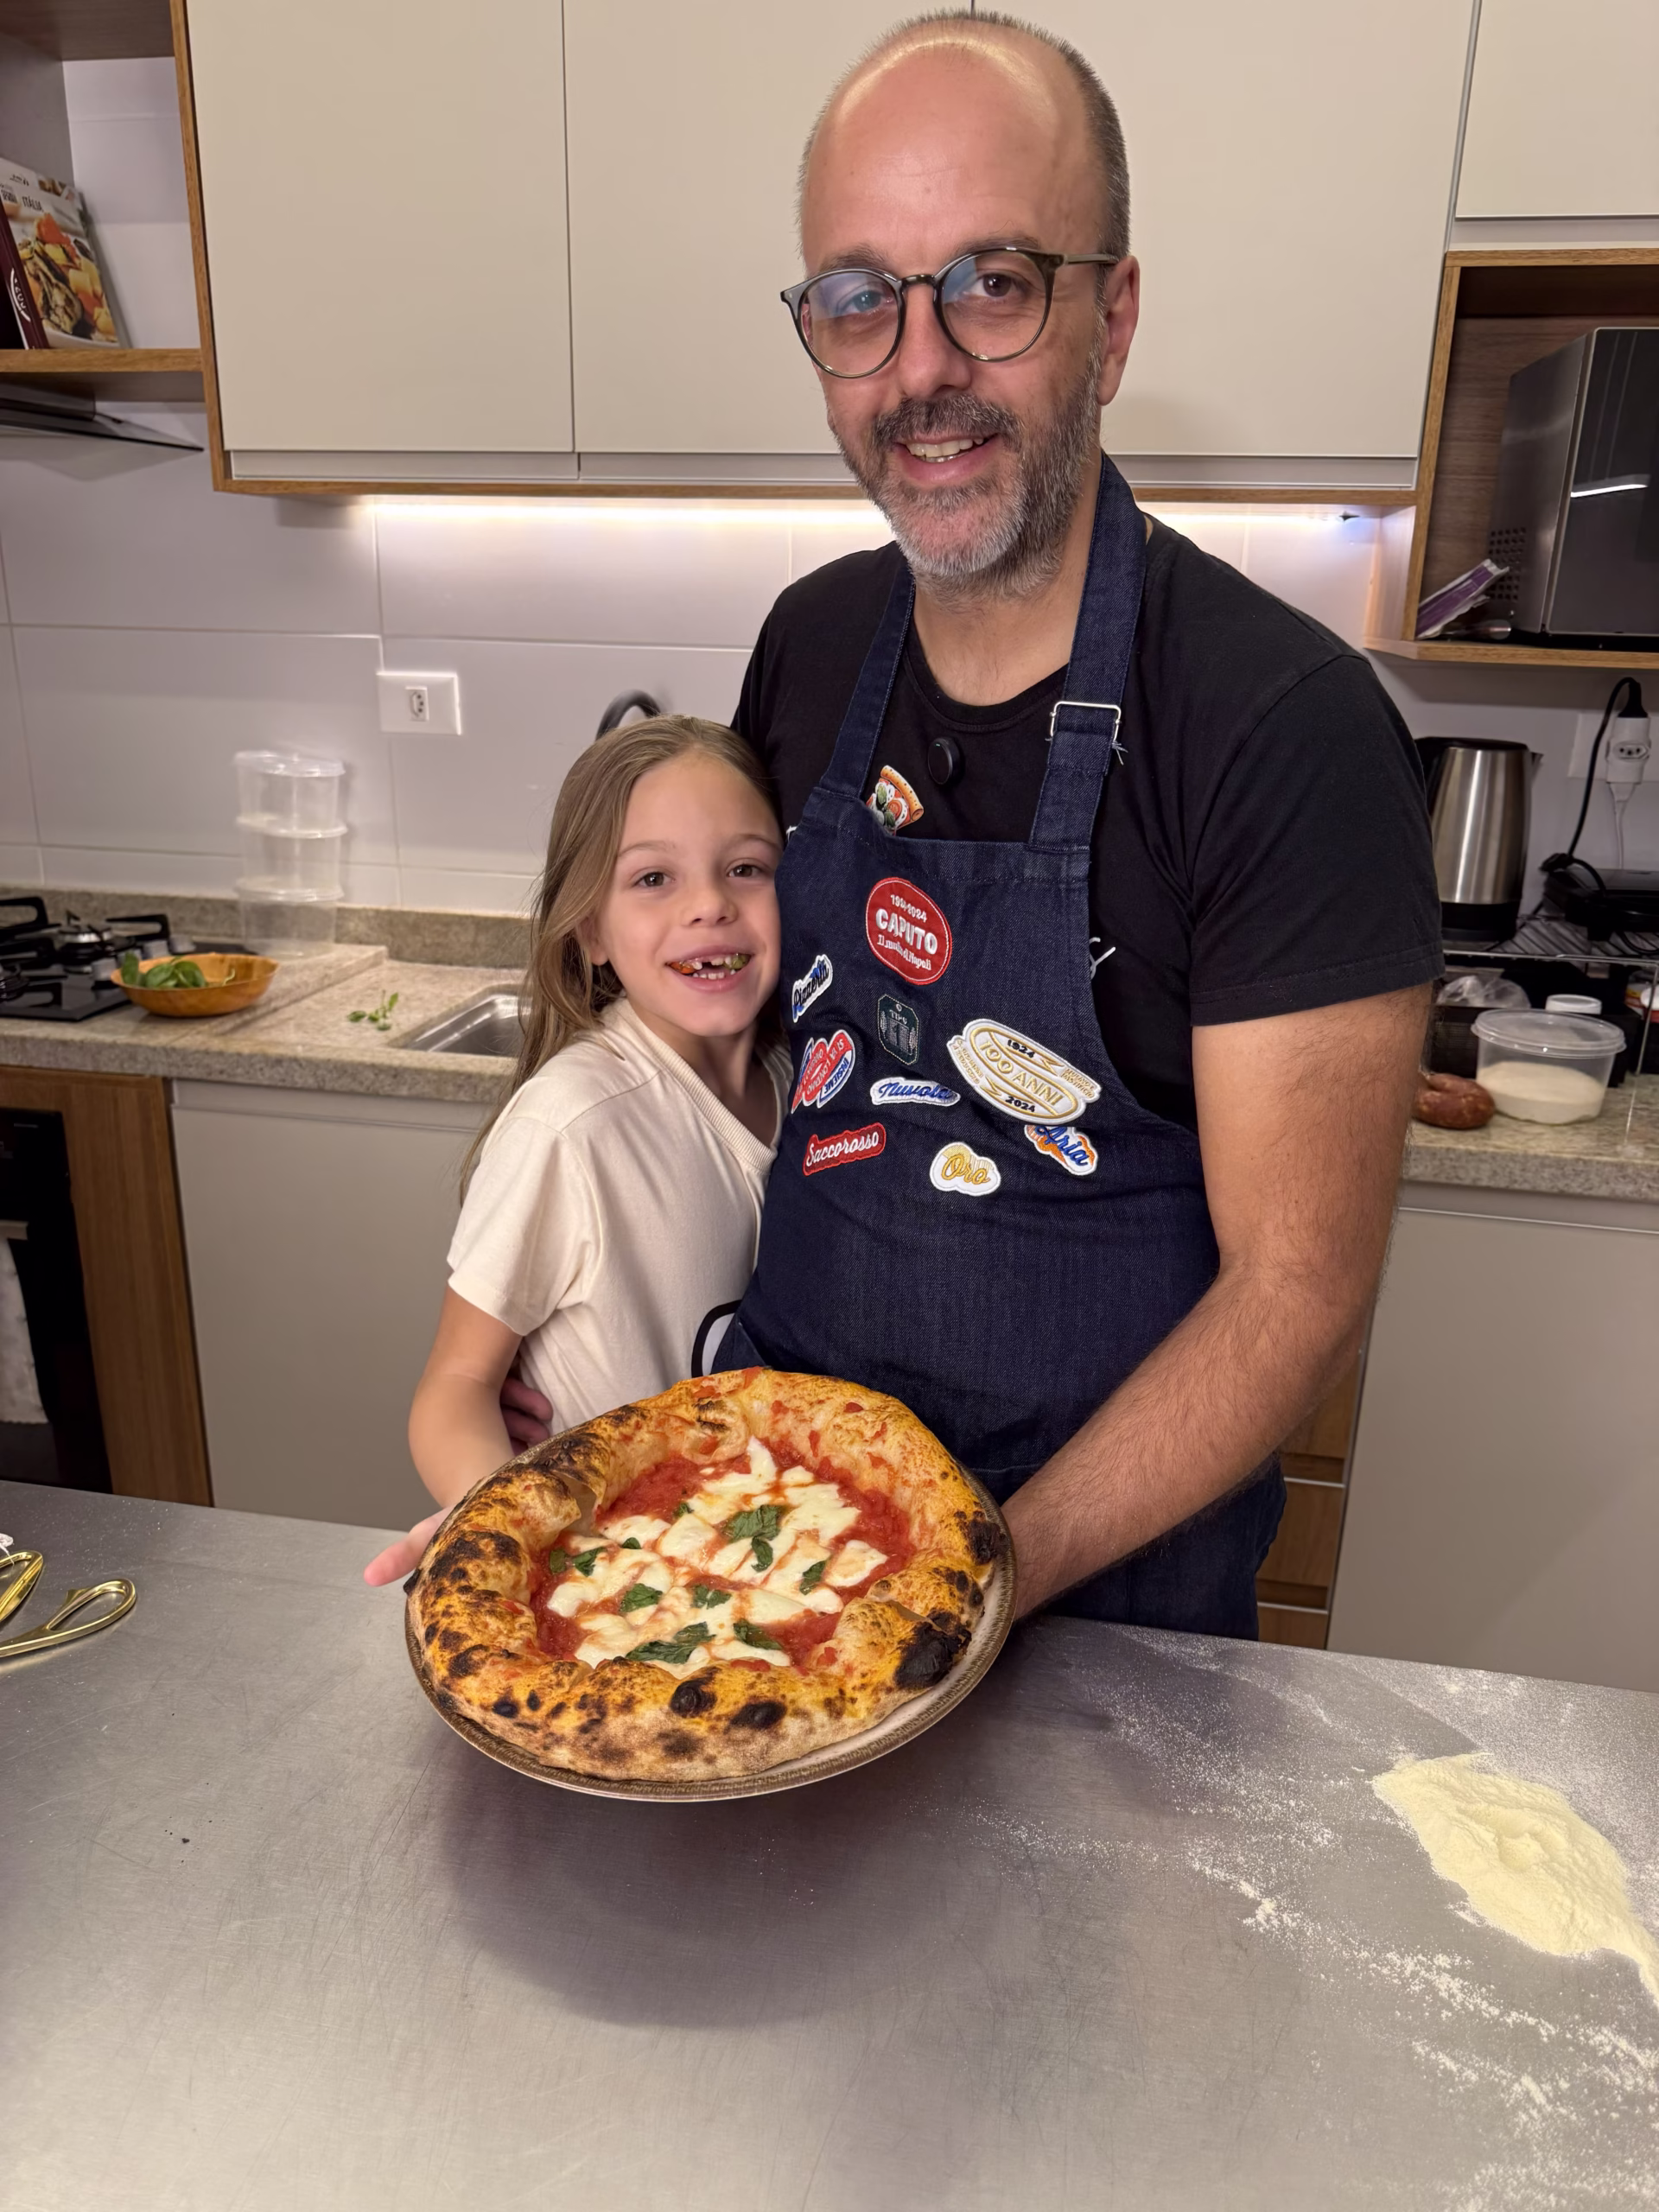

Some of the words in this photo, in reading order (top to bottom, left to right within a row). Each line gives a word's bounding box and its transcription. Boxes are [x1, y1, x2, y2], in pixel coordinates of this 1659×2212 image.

[875, 908, 938, 955] CAPUTO
[1007, 1039, 1035, 1058] 1924
[824, 1058, 849, 1094] INSIEME
[879, 1082, 952, 1100] Nuvola
[980, 1041, 1014, 1074] 100
[1013, 1071, 1064, 1106] ANNI
[1005, 1096, 1035, 1113] 2024
[806, 1131, 879, 1166] Saccorosso
[1035, 1126, 1090, 1166] Aria
[941, 1154, 991, 1185] Oro
